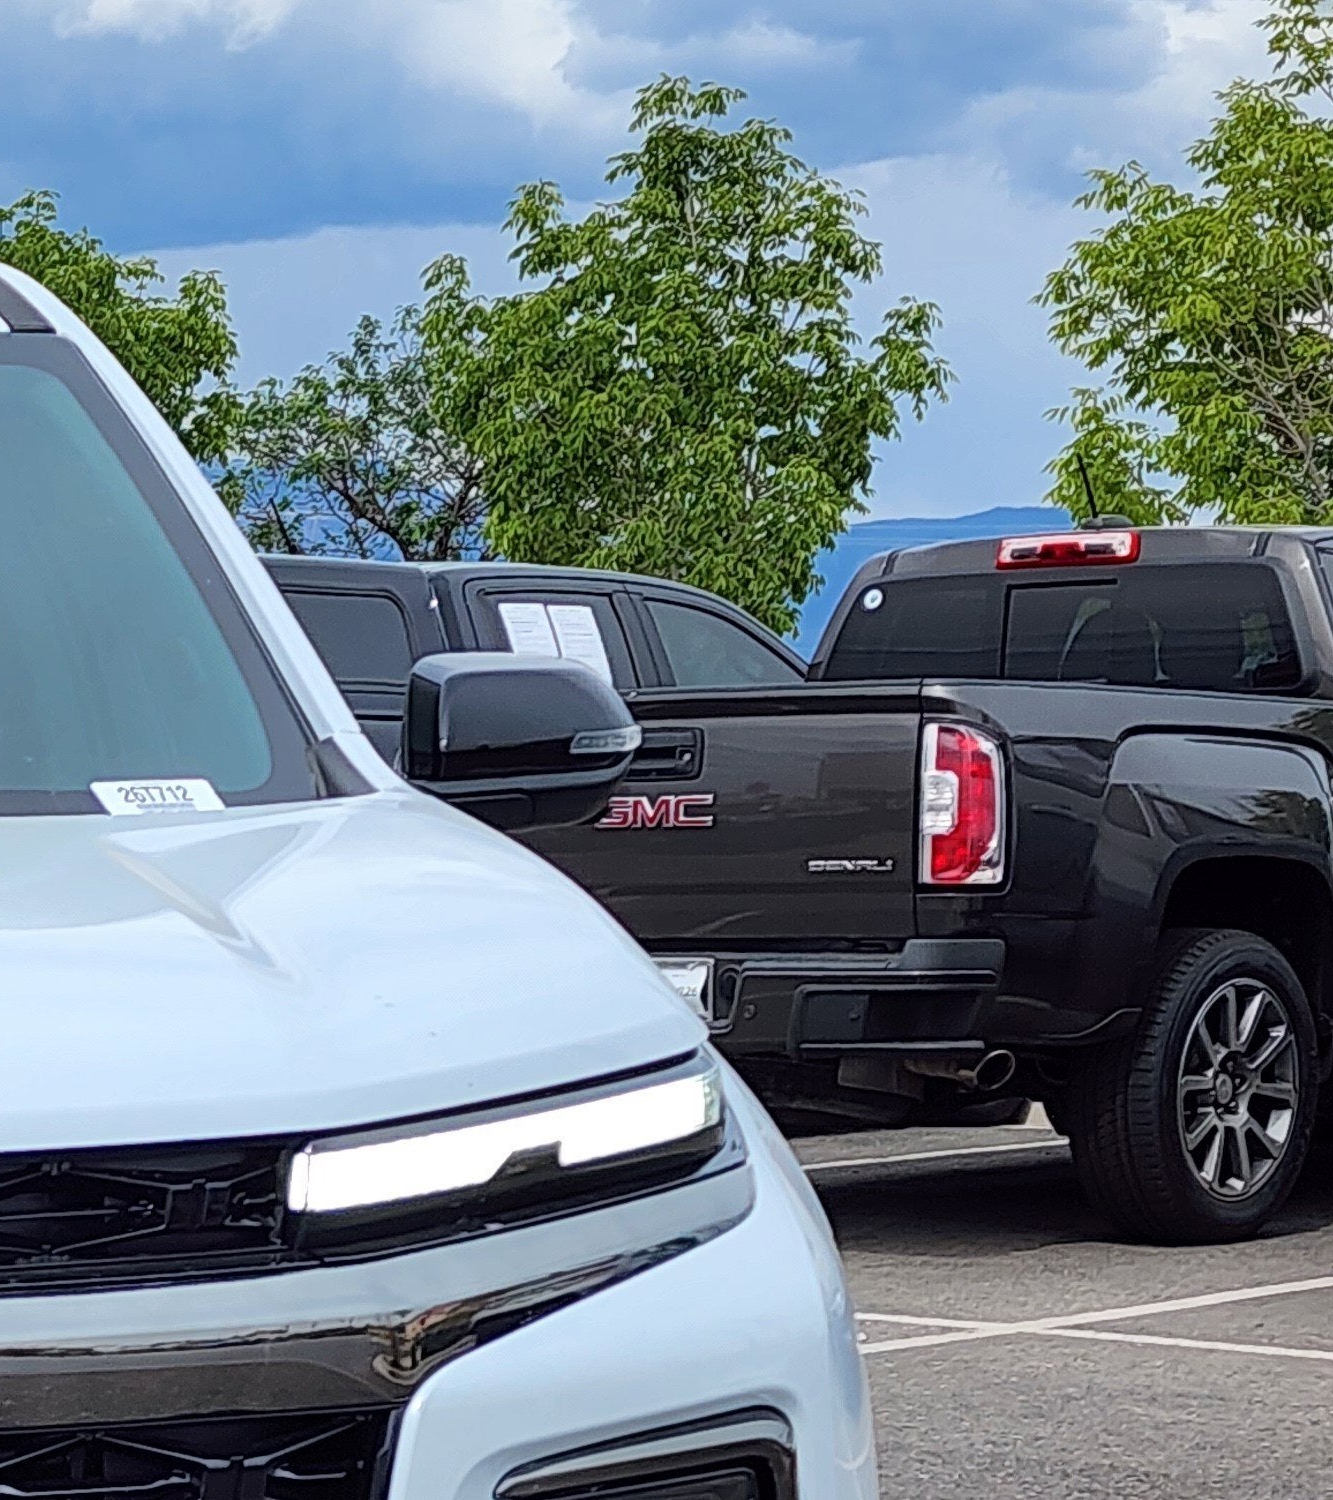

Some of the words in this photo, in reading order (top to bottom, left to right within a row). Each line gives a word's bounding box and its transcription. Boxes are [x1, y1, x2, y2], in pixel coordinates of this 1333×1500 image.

[117, 785, 194, 803] 26T712
[595, 794, 715, 828] GMC
[807, 859, 894, 872] DENALI
